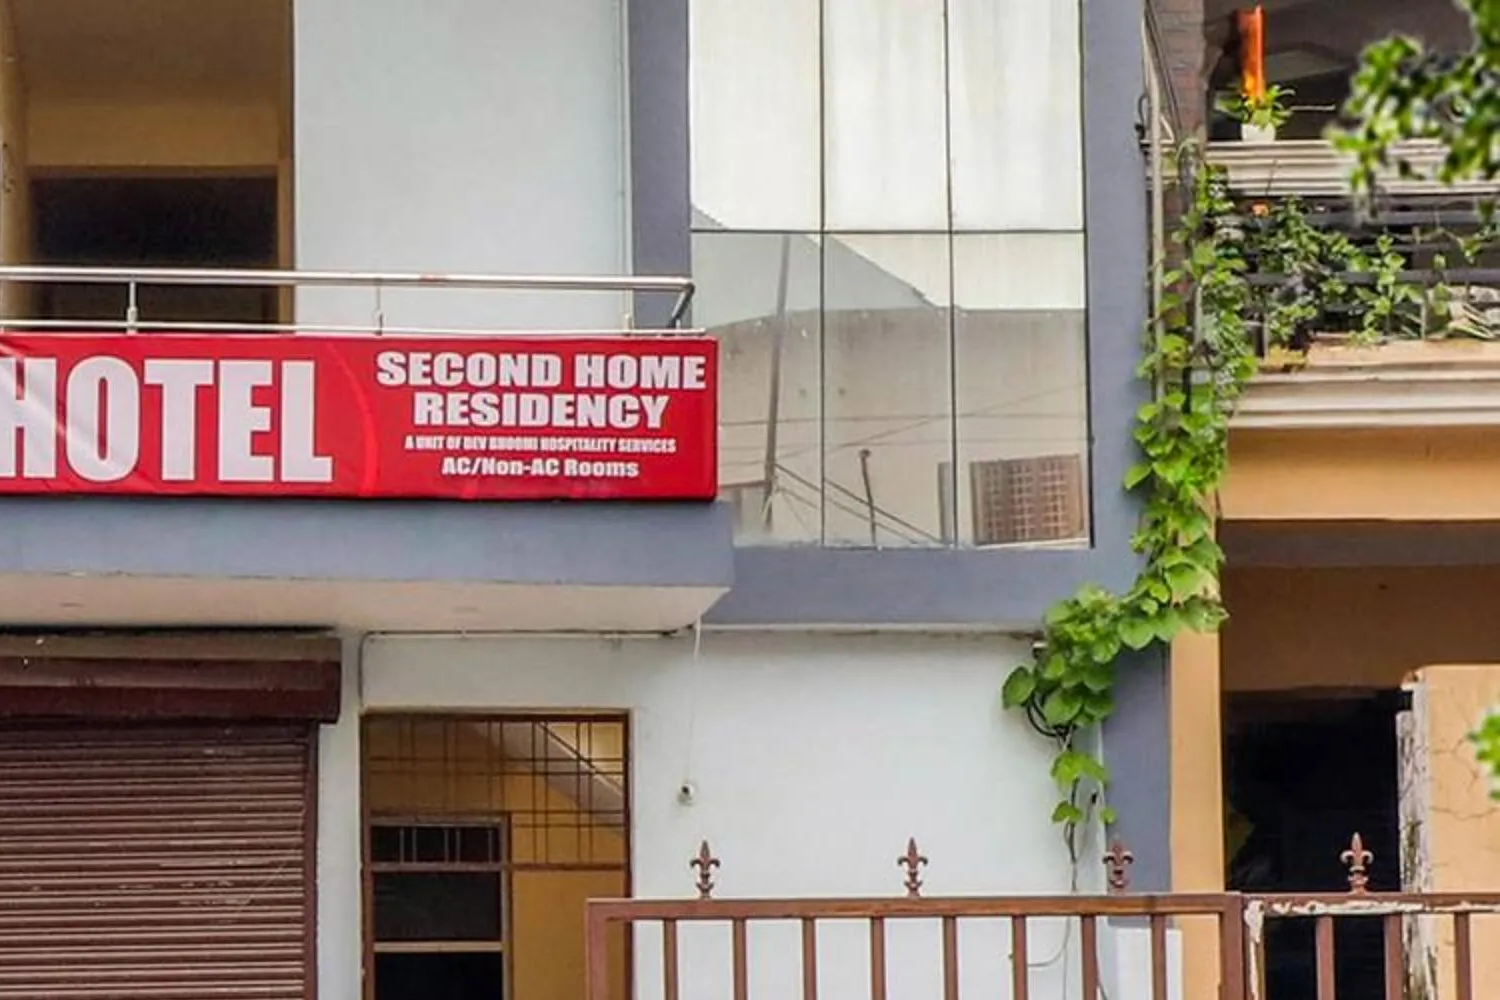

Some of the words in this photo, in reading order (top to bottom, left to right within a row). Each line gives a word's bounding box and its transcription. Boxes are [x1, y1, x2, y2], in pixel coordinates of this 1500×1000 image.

[376, 351, 562, 387] SECOND
[574, 354, 707, 389] HOME
[414, 391, 669, 429] RESIDENCY
[404, 436, 415, 450] A
[540, 437, 616, 453] HOSPITALITY
[617, 438, 676, 453] SERVICES
[441, 456, 560, 477] AC/Non-AC
[564, 459, 639, 478] Rooms
